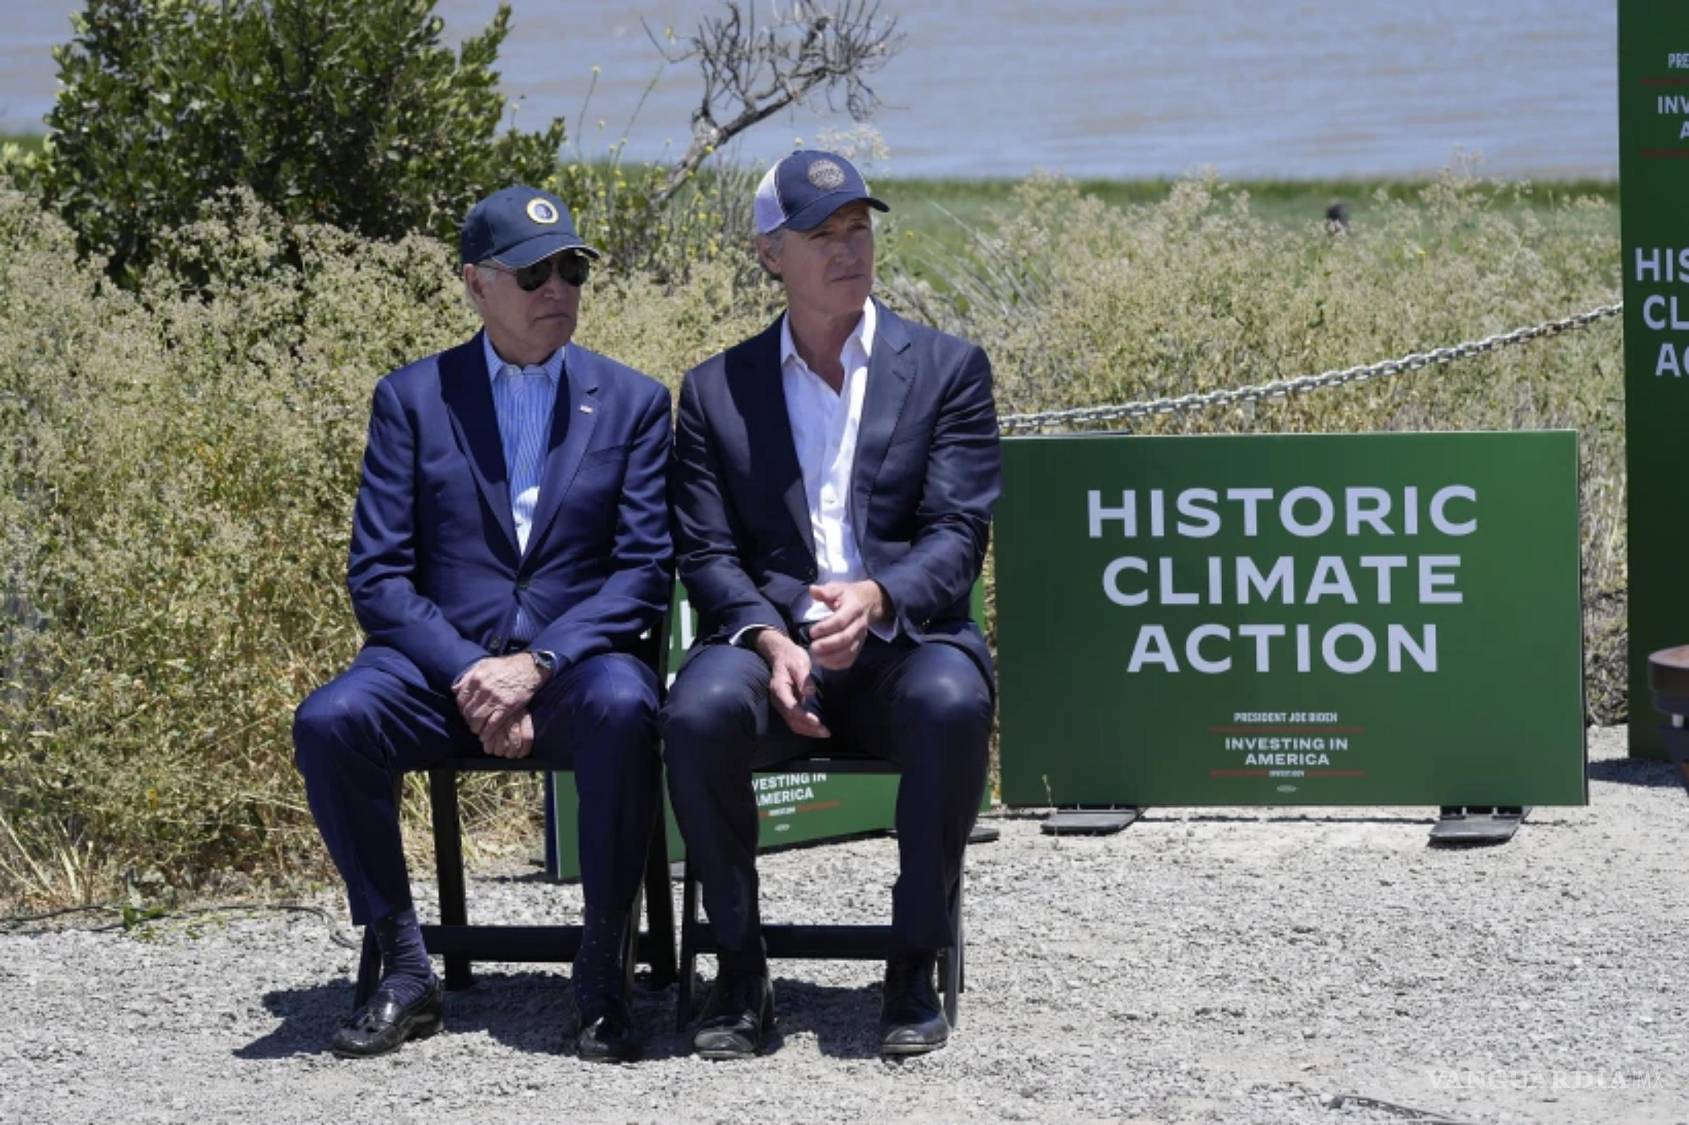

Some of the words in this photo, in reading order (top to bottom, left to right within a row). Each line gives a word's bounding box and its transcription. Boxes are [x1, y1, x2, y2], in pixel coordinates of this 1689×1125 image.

[1643, 294, 1689, 330] CL
[1655, 342, 1689, 377] A
[1088, 485, 1478, 538] HISTORIC
[1103, 555, 1463, 606] CLIMATE
[1127, 622, 1438, 674] ACTION
[1234, 712, 1287, 722] PRESIDENT
[1225, 737, 1326, 751] INVESTING
[1330, 737, 1348, 750] IN
[1244, 753, 1330, 766] AMERICA
